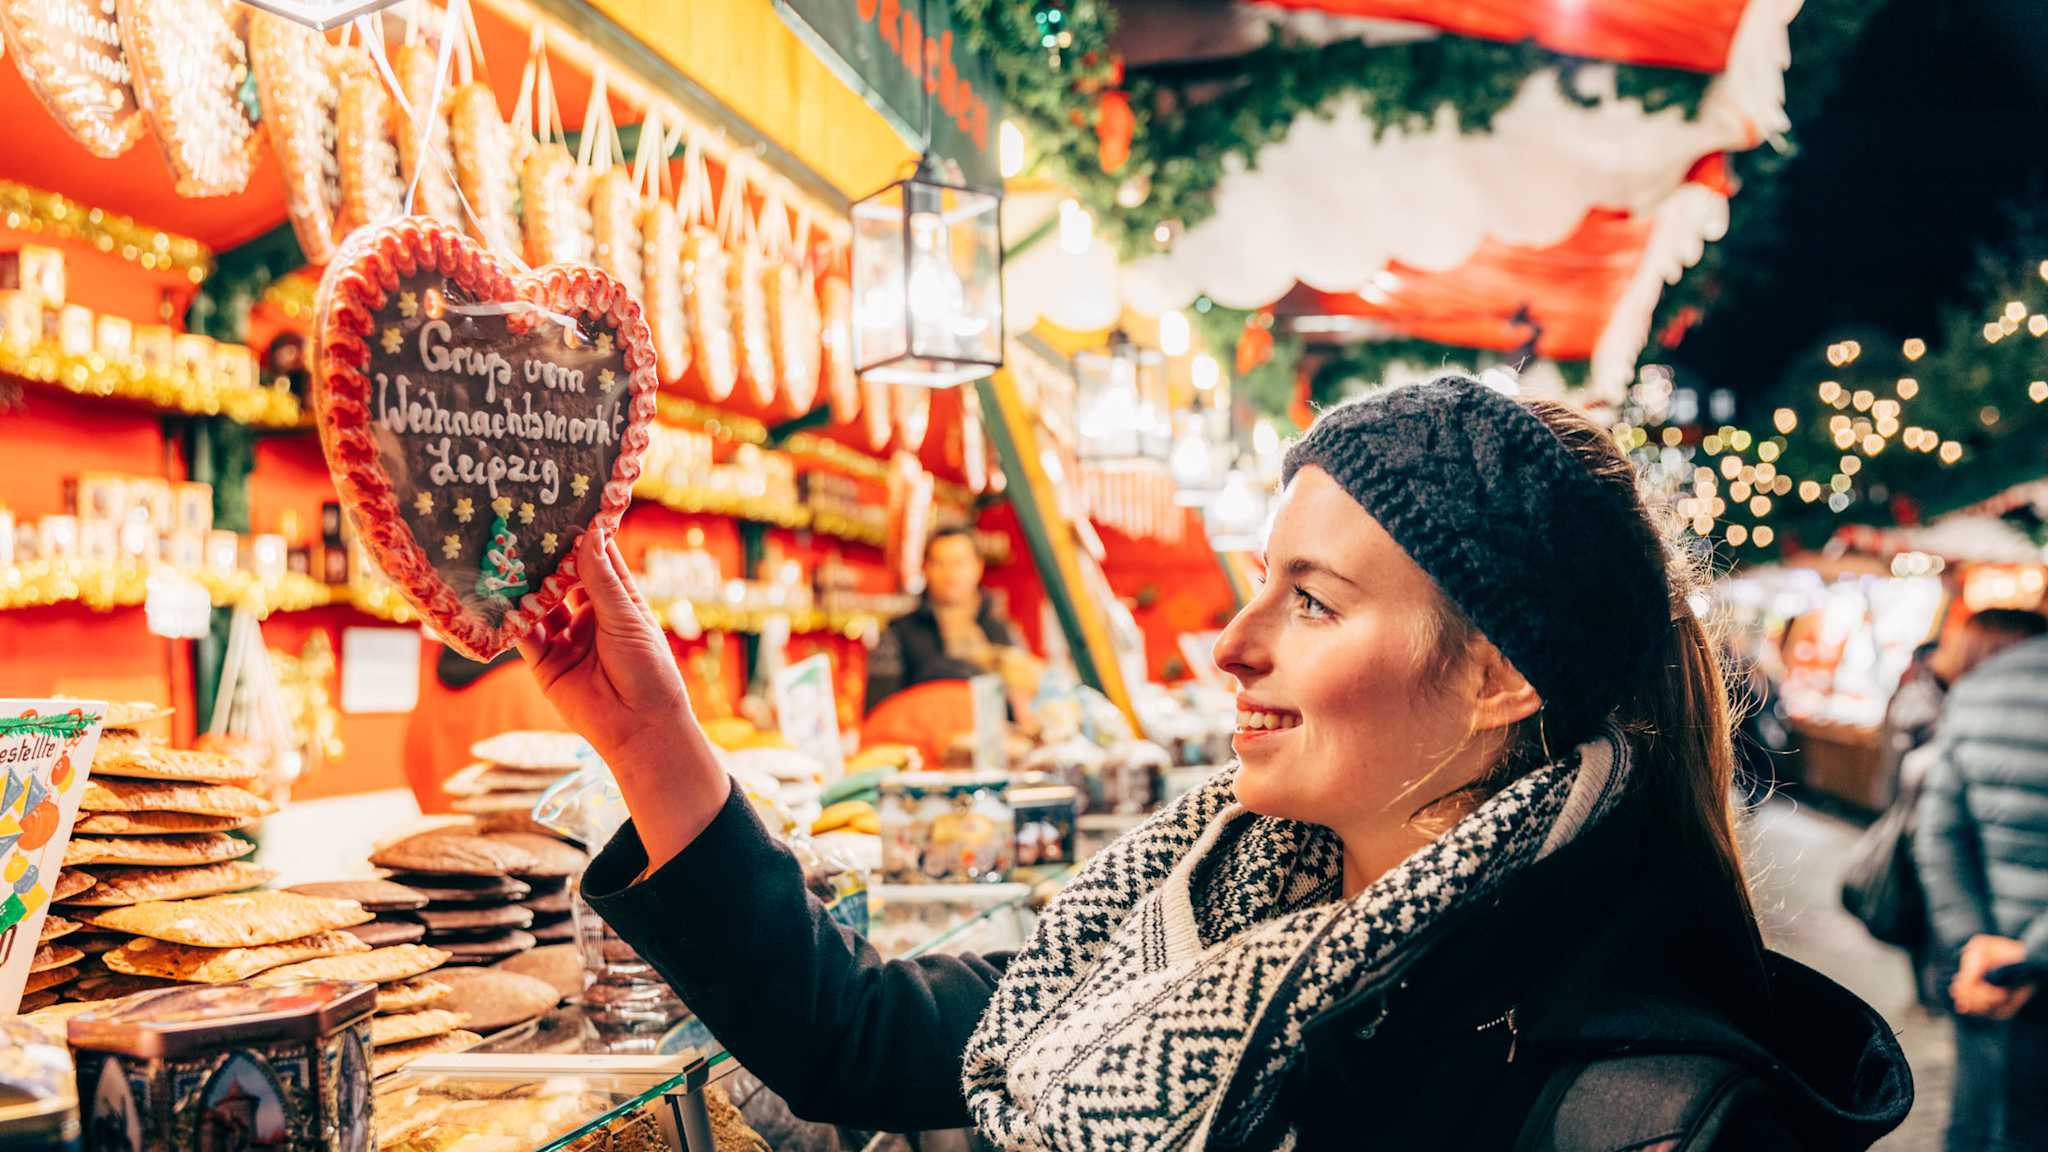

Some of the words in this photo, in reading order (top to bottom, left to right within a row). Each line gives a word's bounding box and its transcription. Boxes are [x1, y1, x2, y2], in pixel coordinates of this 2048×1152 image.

[376, 373, 624, 446] Weihnachtsmarkt
[524, 360, 586, 393] vom
[426, 437, 560, 505] Leipzig
